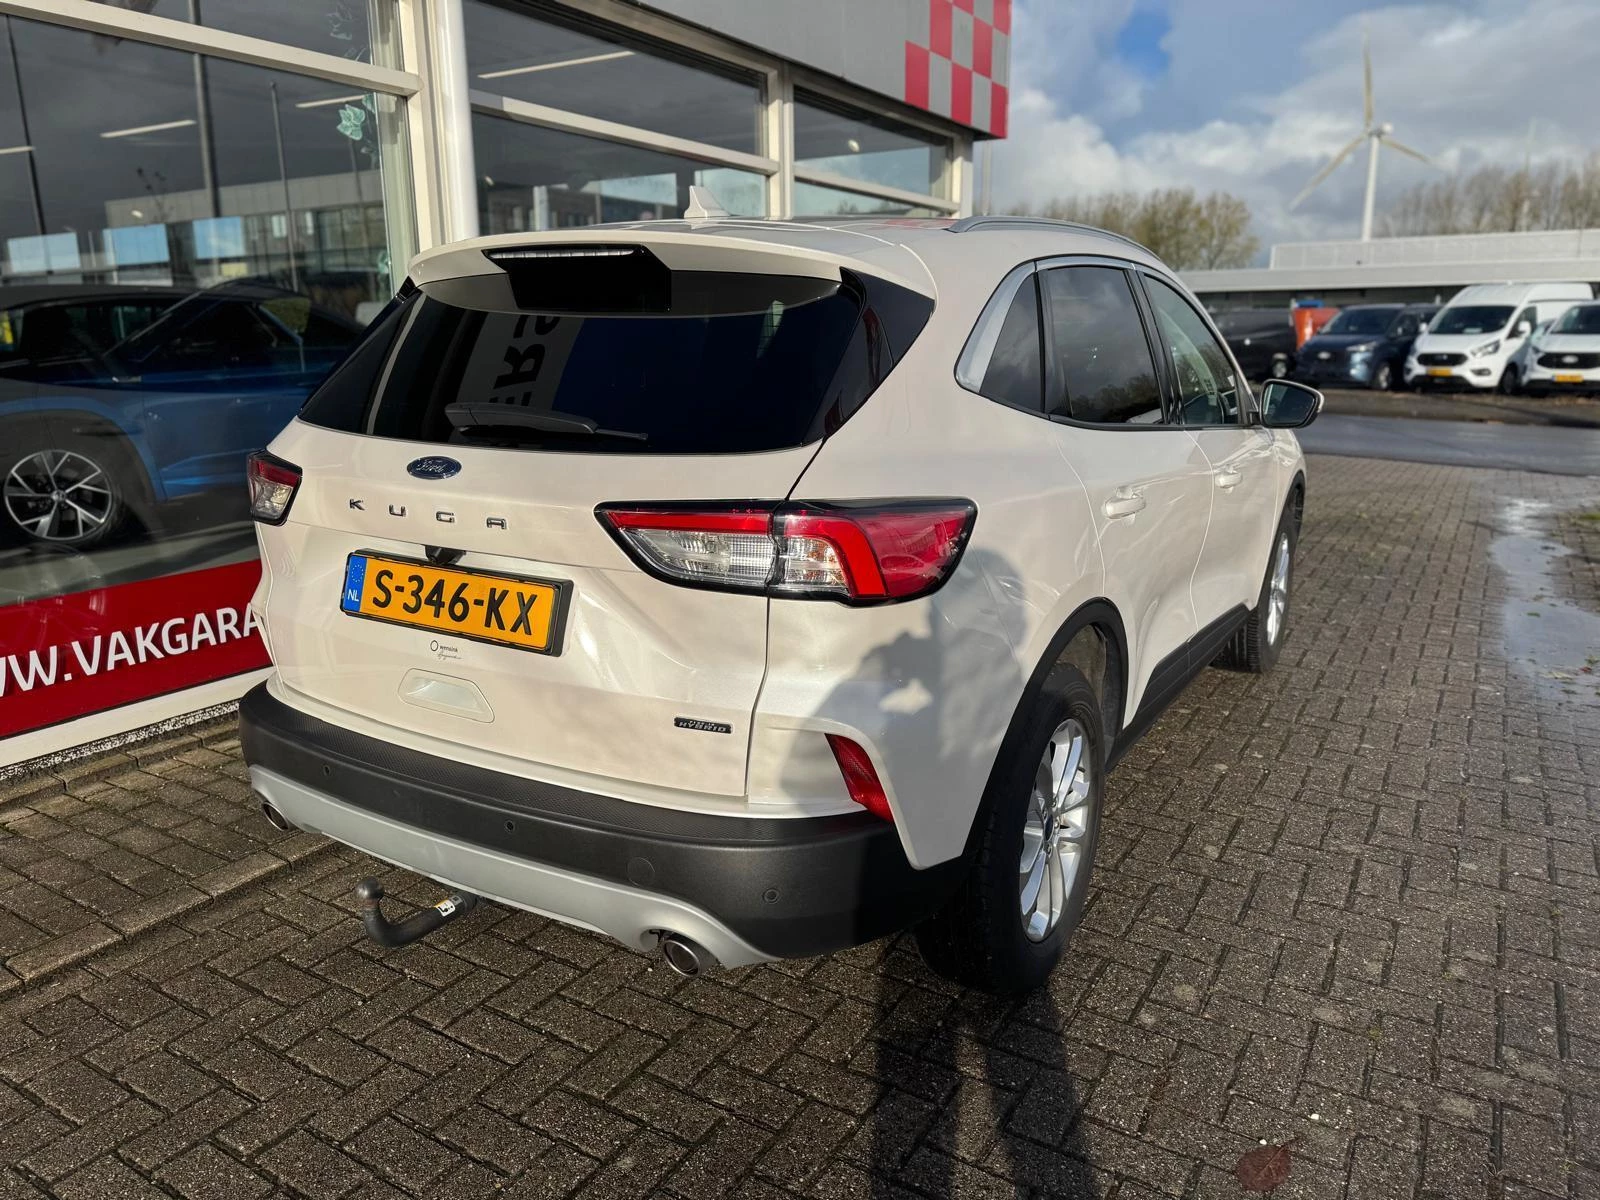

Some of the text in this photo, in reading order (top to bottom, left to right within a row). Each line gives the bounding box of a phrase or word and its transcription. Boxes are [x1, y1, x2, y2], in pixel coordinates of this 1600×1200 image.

[349, 498, 507, 530] KUGA
[347, 588, 359, 602] NL
[372, 569, 538, 636] S-346-KX
[0, 602, 258, 697] W.VAKGARA
